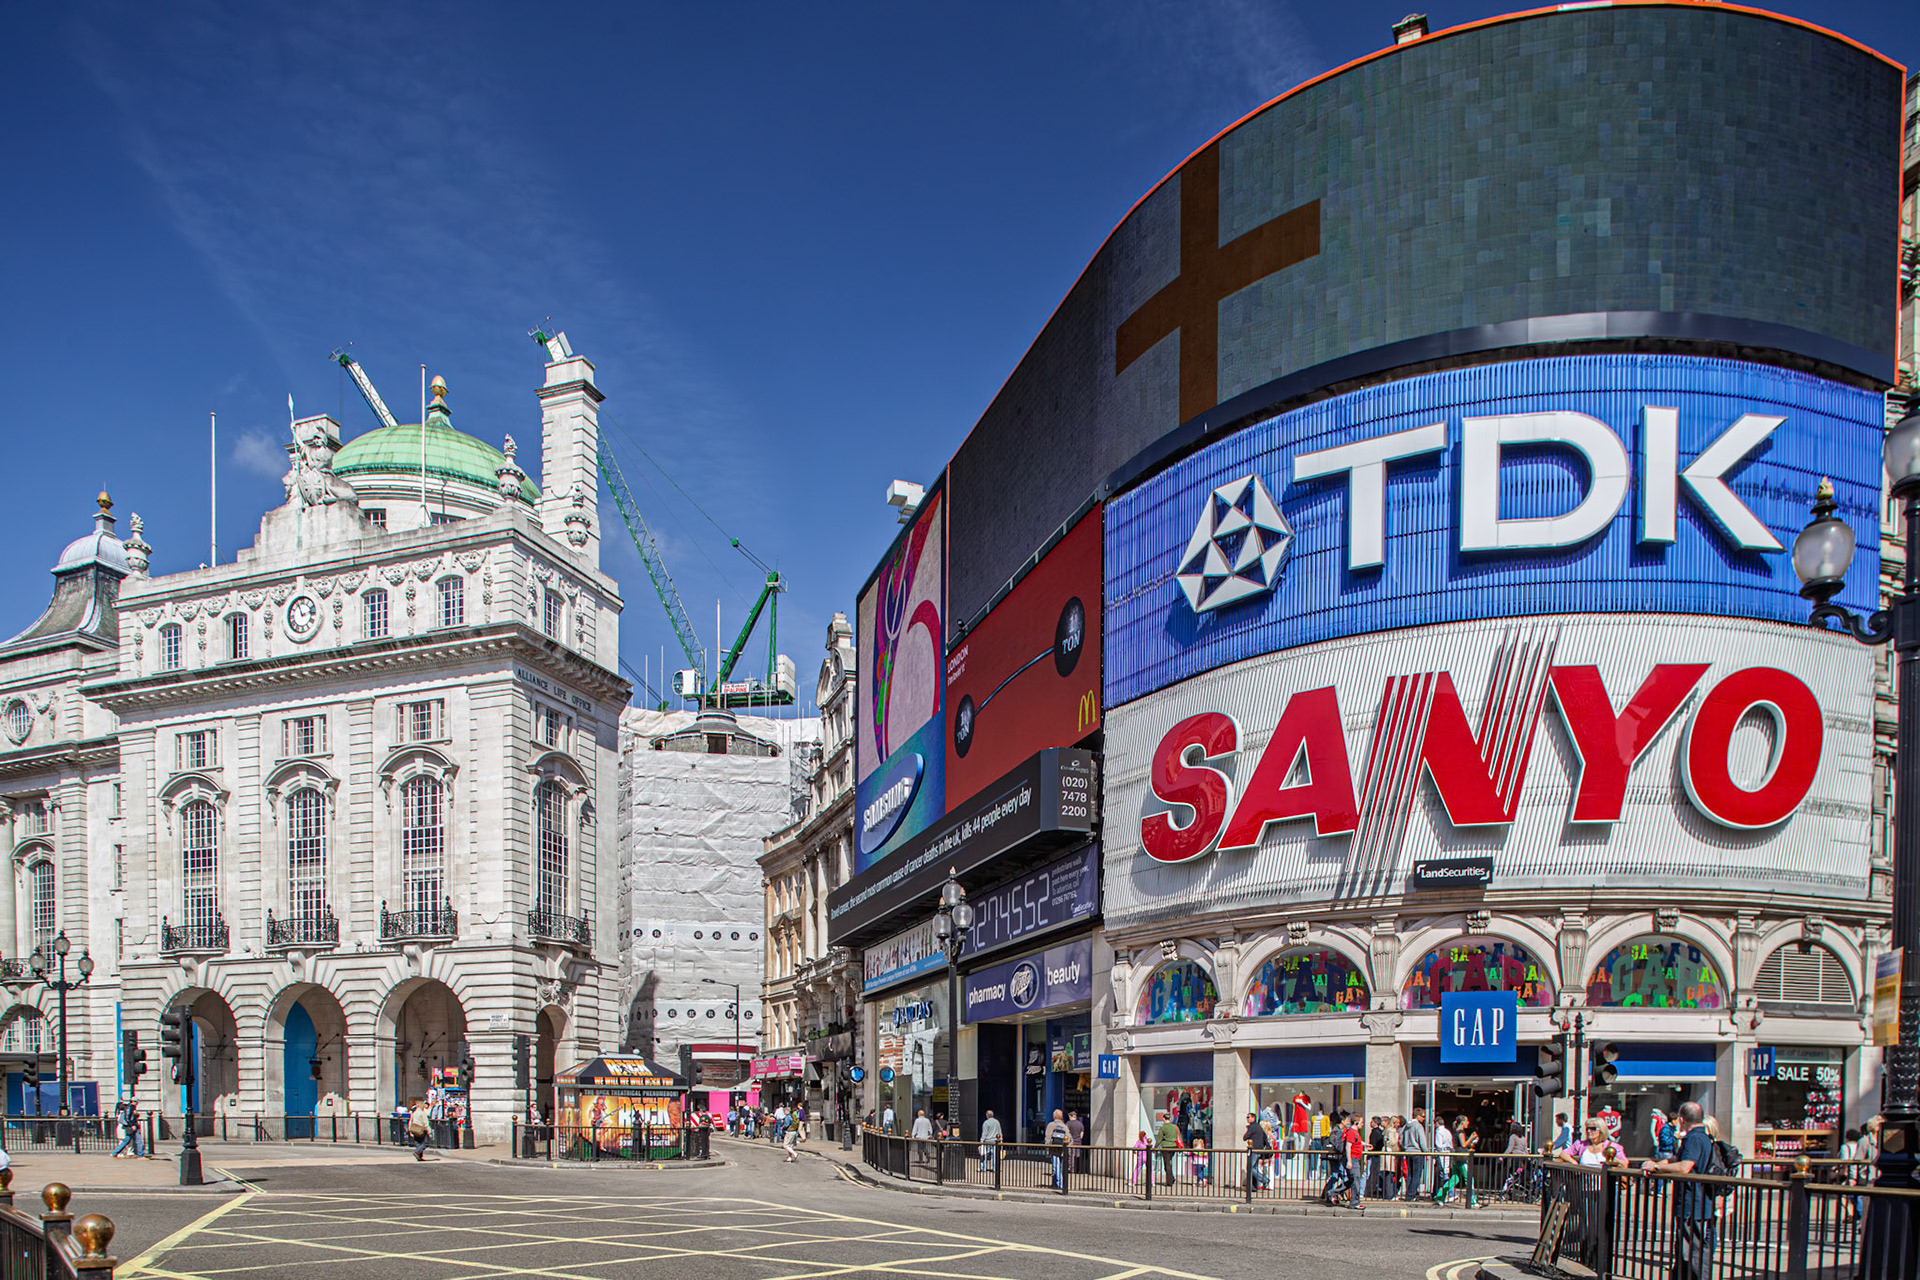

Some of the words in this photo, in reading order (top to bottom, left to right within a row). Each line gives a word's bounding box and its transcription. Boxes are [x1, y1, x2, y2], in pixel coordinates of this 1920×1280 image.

[1293, 405, 1788, 570] TDK
[1062, 630, 1080, 654] TON
[518, 668, 549, 691] ALLIANCE
[553, 686, 567, 701] LIFE
[571, 695, 592, 713] OFFICE
[1141, 626, 1825, 870] SANYO
[1062, 776, 1088, 789] (020)
[863, 777, 914, 833] SAMSUNG
[1061, 790, 1087, 803] 7478
[1061, 805, 1087, 817] 2200
[909, 856, 923, 872] cancer
[923, 844, 939, 864] deaths
[939, 841, 944, 855] in
[943, 835, 953, 852] the
[961, 821, 972, 842] kills
[972, 815, 981, 833] 44
[981, 804, 1001, 833] people
[1001, 795, 1019, 816] every
[1018, 787, 1032, 806] day
[1421, 866, 1486, 878] LandSecurities
[1010, 966, 1033, 998] Boots
[1047, 961, 1080, 986] beauty
[1267, 961, 1347, 1010] GAP
[1429, 952, 1526, 1004] GAP
[1611, 951, 1699, 1002] GAP
[969, 983, 1006, 1009] pharmacy
[1151, 973, 1204, 1019] GAP
[1336, 987, 1364, 1004] GAP
[1686, 983, 1715, 1001] GAP
[900, 1000, 933, 1024] BARCLAYS
[1453, 1008, 1505, 1046] GAP
[1102, 1060, 1117, 1074] GAP
[1750, 1053, 1769, 1071] GAP
[1777, 1066, 1809, 1081] SALE
[1816, 1066, 1840, 1081] 50%
[585, 1089, 595, 1097] THE
[596, 1089, 610, 1097] ROCK
[611, 1089, 641, 1097] THEATRICAL
[643, 1089, 679, 1097] PHENOMENON!
[594, 1076, 603, 1085] WE
[604, 1076, 618, 1085] WILL
[620, 1077, 629, 1086] WE
[630, 1077, 644, 1086] WILL
[644, 1077, 660, 1086] ROCK
[618, 1097, 671, 1134] ROCK
